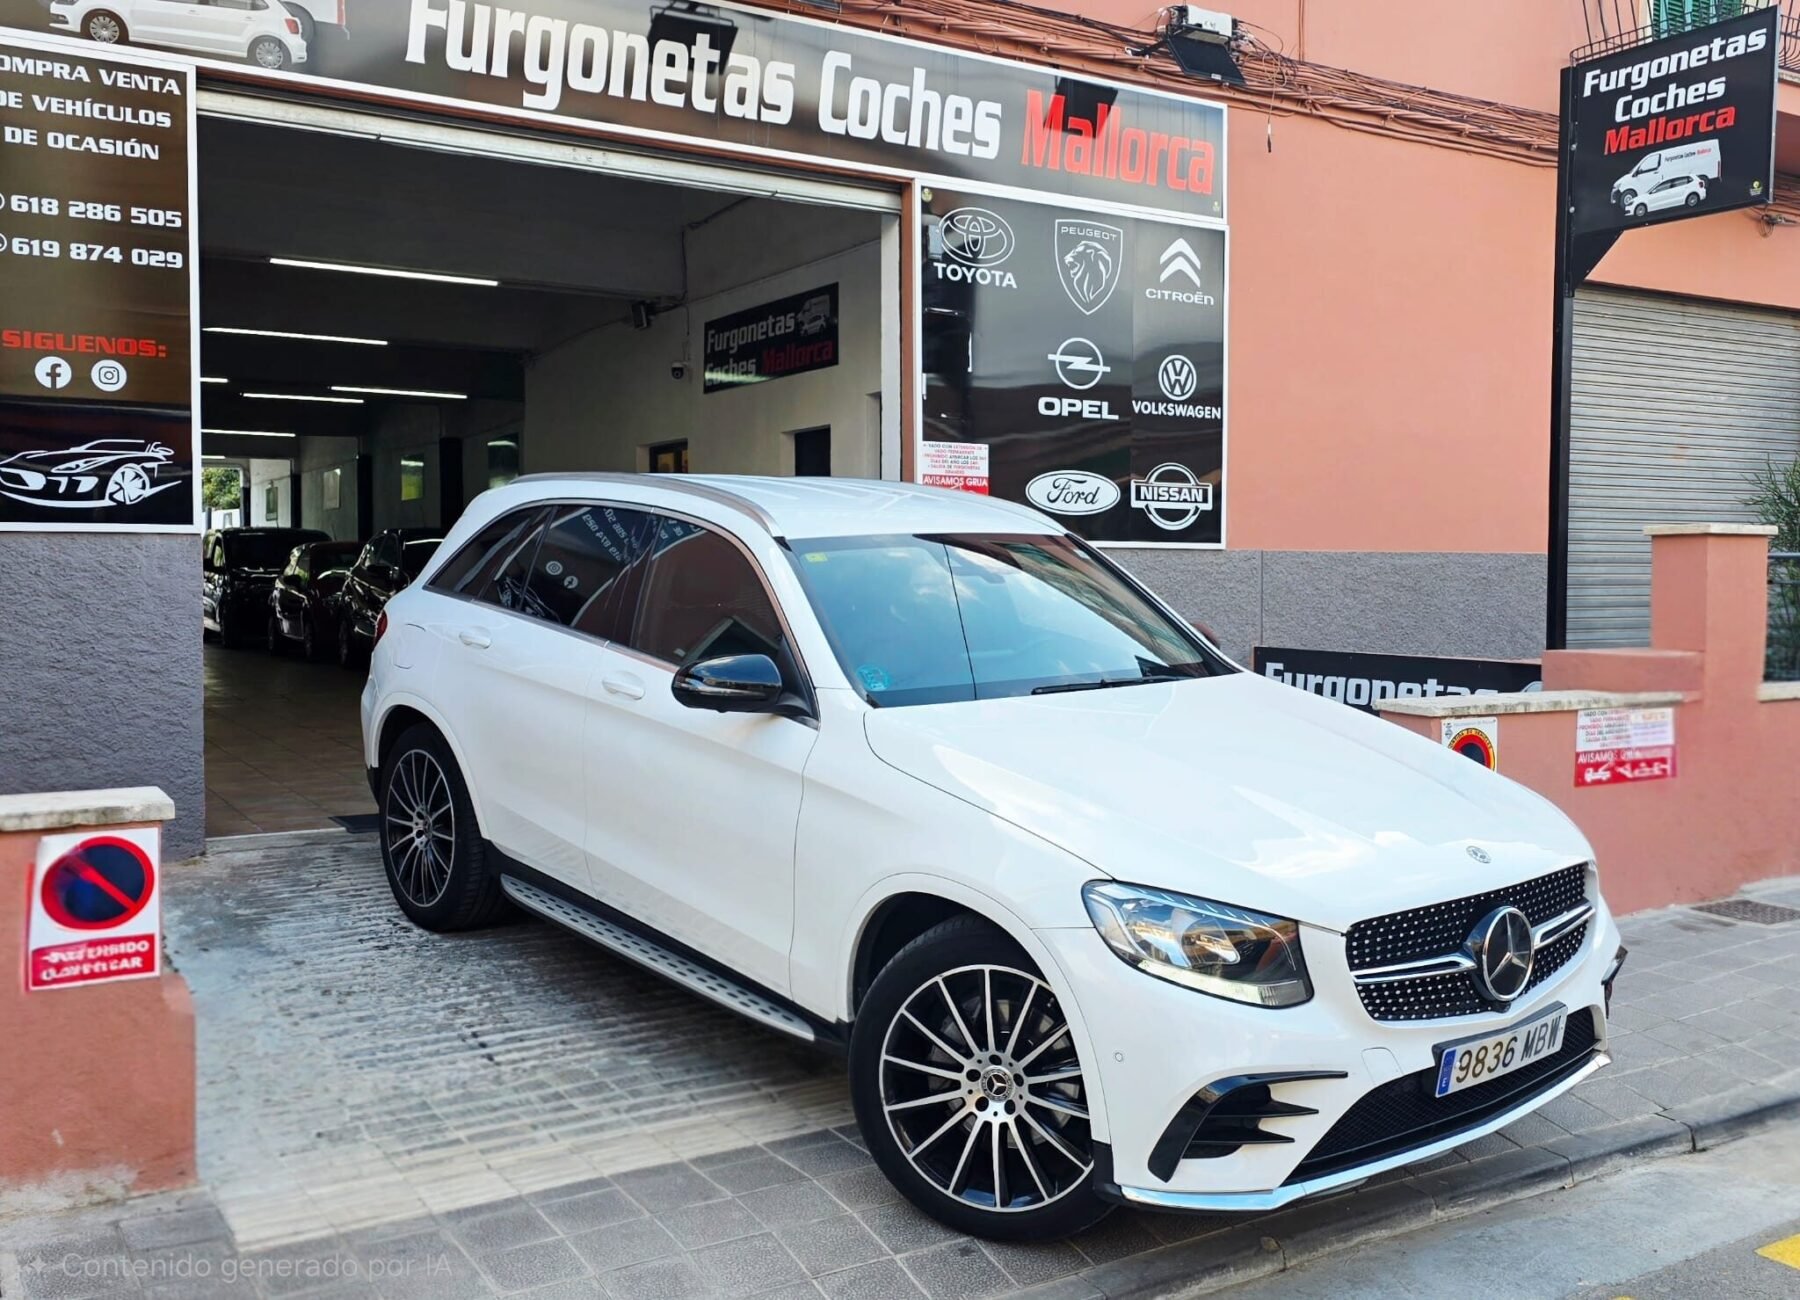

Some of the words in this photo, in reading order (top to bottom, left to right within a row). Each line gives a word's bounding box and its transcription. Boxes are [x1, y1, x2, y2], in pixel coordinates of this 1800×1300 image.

[0, 54, 91, 83] OMPRA
[98, 68, 181, 96] VENTA
[1583, 28, 1768, 98] Furgonetas
[31, 94, 172, 129] VEHÍCULOS
[405, 0, 796, 126] Furgonetas
[817, 50, 1002, 160] Coches
[1021, 88, 1214, 195] Mallorca
[1614, 76, 1727, 123] Coches
[4, 126, 38, 146] DE
[47, 131, 160, 160] OCASIÓN
[1604, 106, 1736, 155] Mallorca
[10, 195, 59, 216] 618
[68, 201, 122, 222] 286
[130, 206, 183, 228] 505
[1060, 226, 1118, 242] PEUGEOT
[11, 237, 60, 258] 619
[69, 243, 123, 263] 874
[131, 249, 183, 269] 029
[933, 261, 1018, 289] TOYOTA
[1, 330, 168, 358] SIGUENOS:
[706, 313, 796, 354] Furgonetas
[761, 341, 833, 374] Mallorca
[1038, 396, 1120, 421] OPEL
[1132, 399, 1222, 420] VOLKSWAGEN
[923, 475, 965, 487] AVISAMOS
[965, 477, 989, 487] GRUA
[1047, 476, 1102, 505] Ford
[1140, 485, 1204, 503] NISSAN
[1265, 662, 1500, 707] Furgonet
[1456, 1037, 1518, 1084] 9836
[1521, 1015, 1562, 1062] MBW
